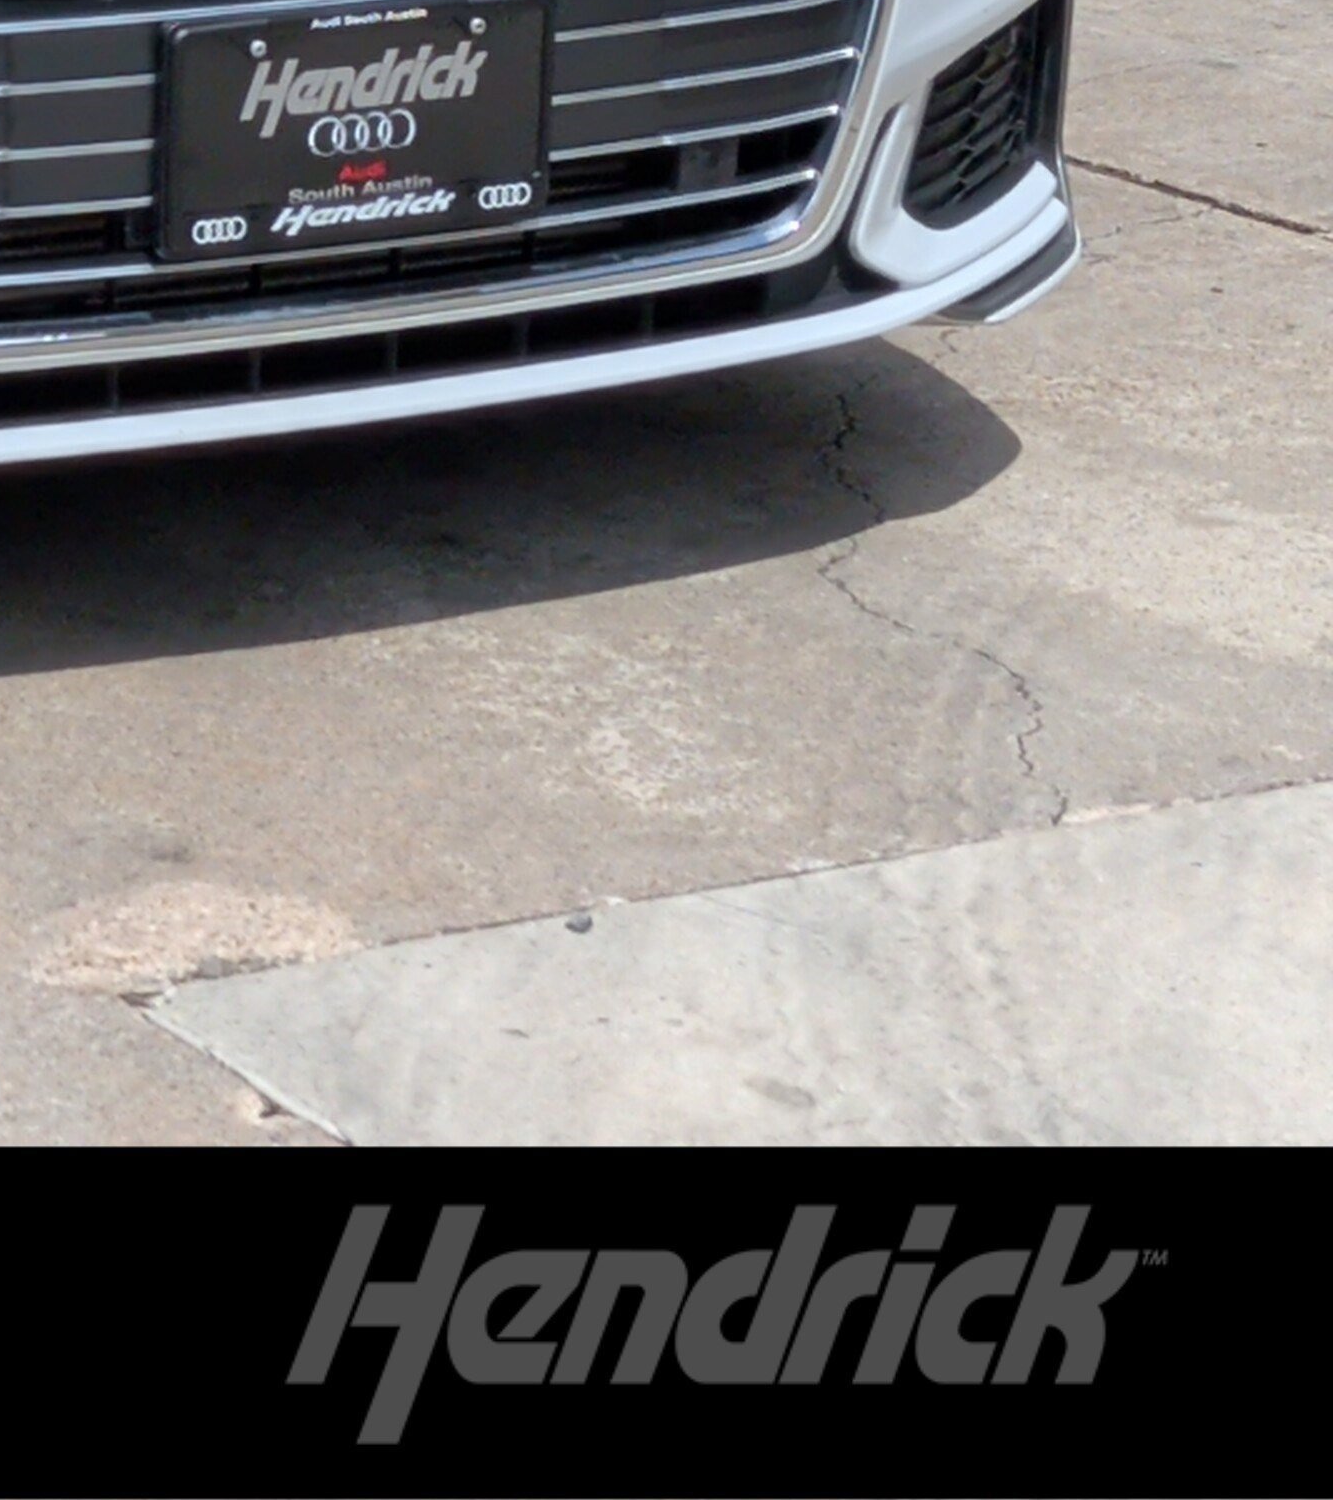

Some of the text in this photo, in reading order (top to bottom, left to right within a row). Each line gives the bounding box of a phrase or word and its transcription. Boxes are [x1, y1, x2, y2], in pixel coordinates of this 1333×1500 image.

[310, 8, 428, 30] Audi South Austin
[240, 40, 488, 139] Hendrick
[339, 161, 386, 179] Audi
[287, 174, 433, 205] South Austin
[270, 188, 456, 236] Hendrick
